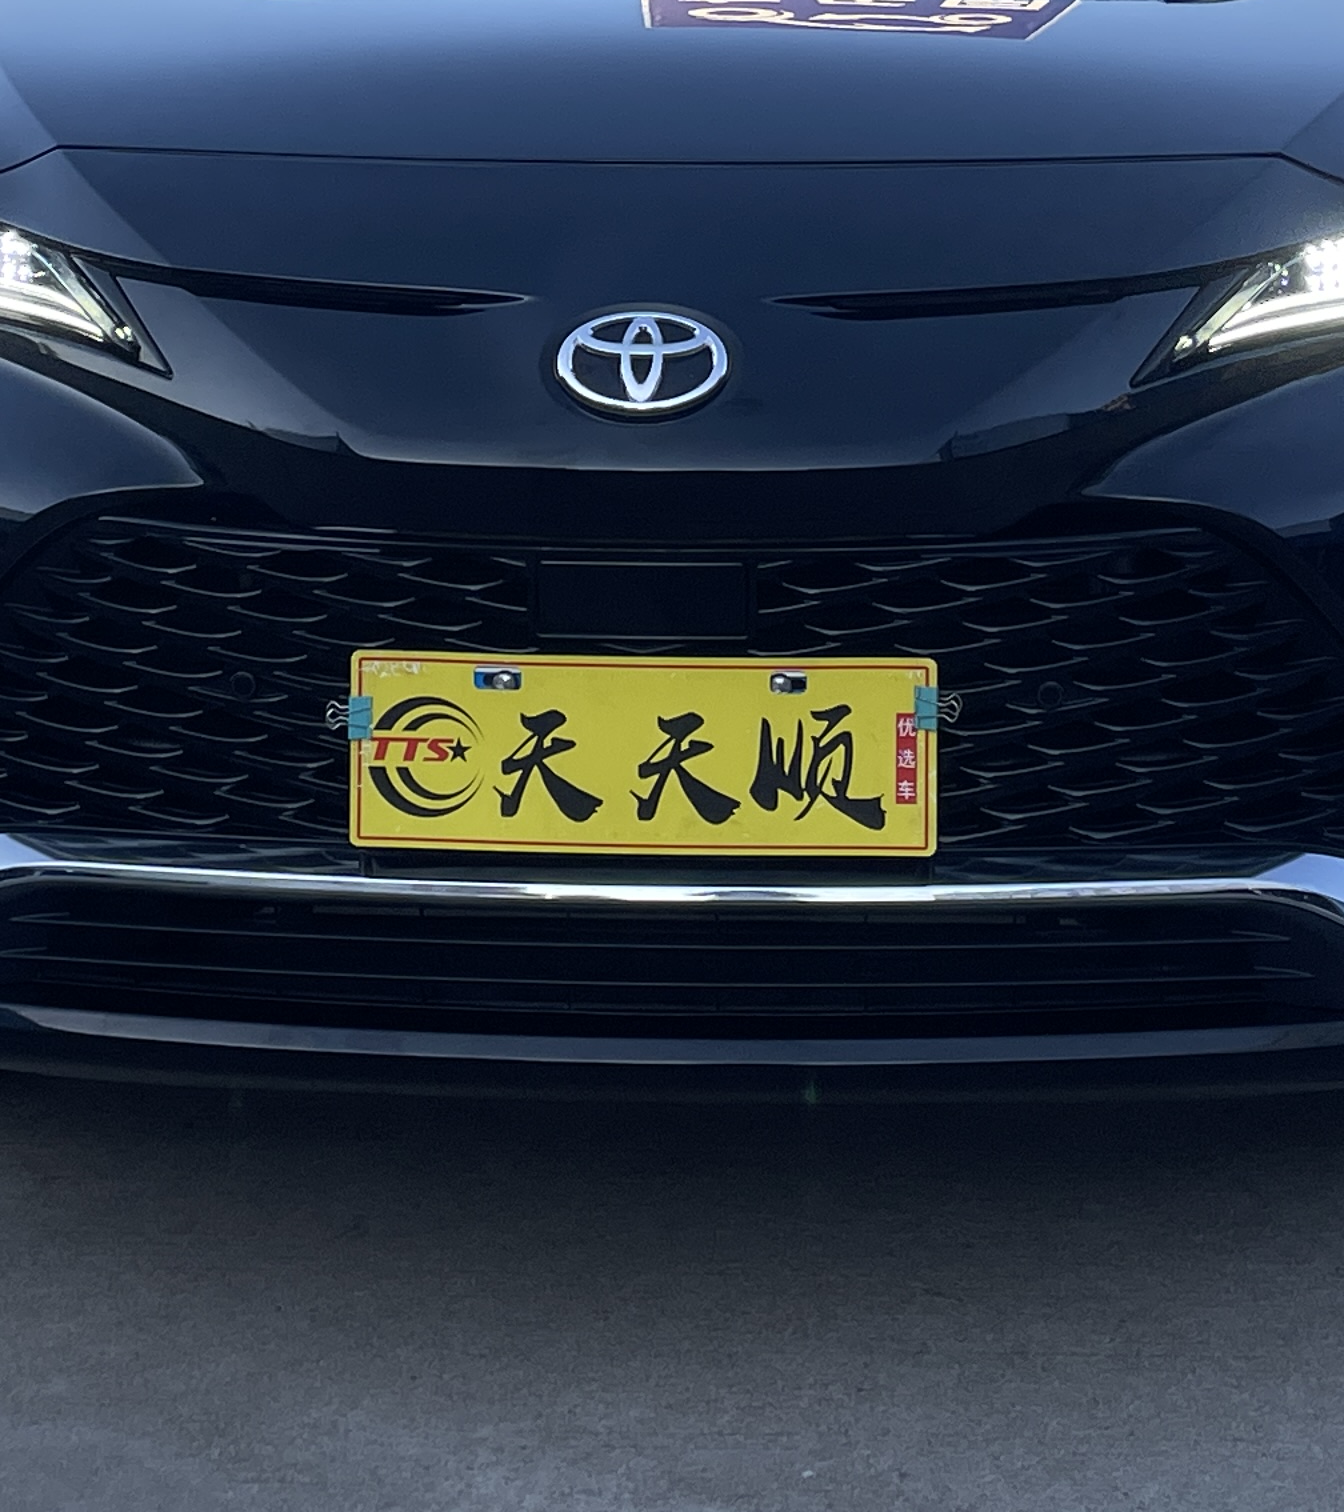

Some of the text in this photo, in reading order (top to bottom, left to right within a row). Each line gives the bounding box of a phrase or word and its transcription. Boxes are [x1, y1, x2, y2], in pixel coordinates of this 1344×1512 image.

[371, 735, 450, 763] TTS
[493, 704, 887, 830] 天天顺
[897, 717, 917, 801] 优选车
